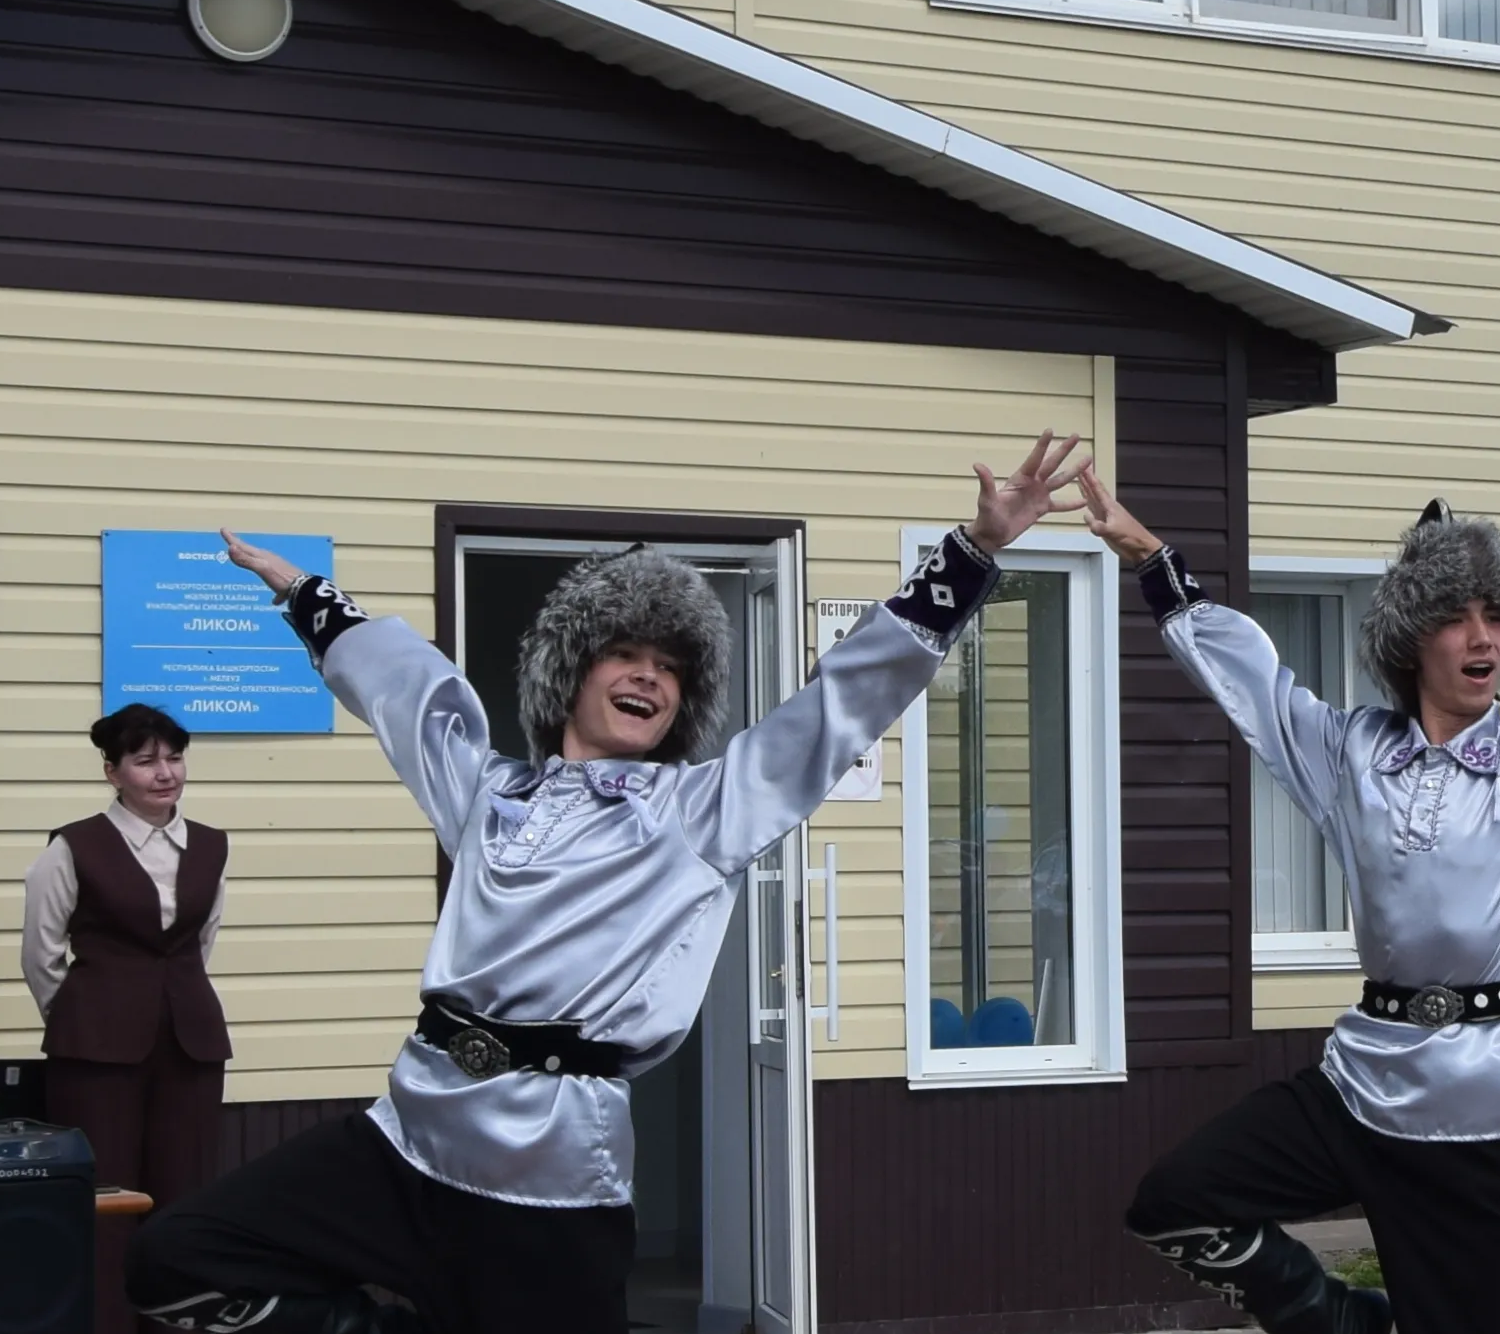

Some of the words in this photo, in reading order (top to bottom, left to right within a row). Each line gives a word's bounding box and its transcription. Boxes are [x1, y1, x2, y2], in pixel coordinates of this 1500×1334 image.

[183, 618, 260, 632] «ЛИКОМ»
[121, 684, 167, 692] ОБЩЕСТВО
[183, 699, 260, 713] «ЛИКОМ»
